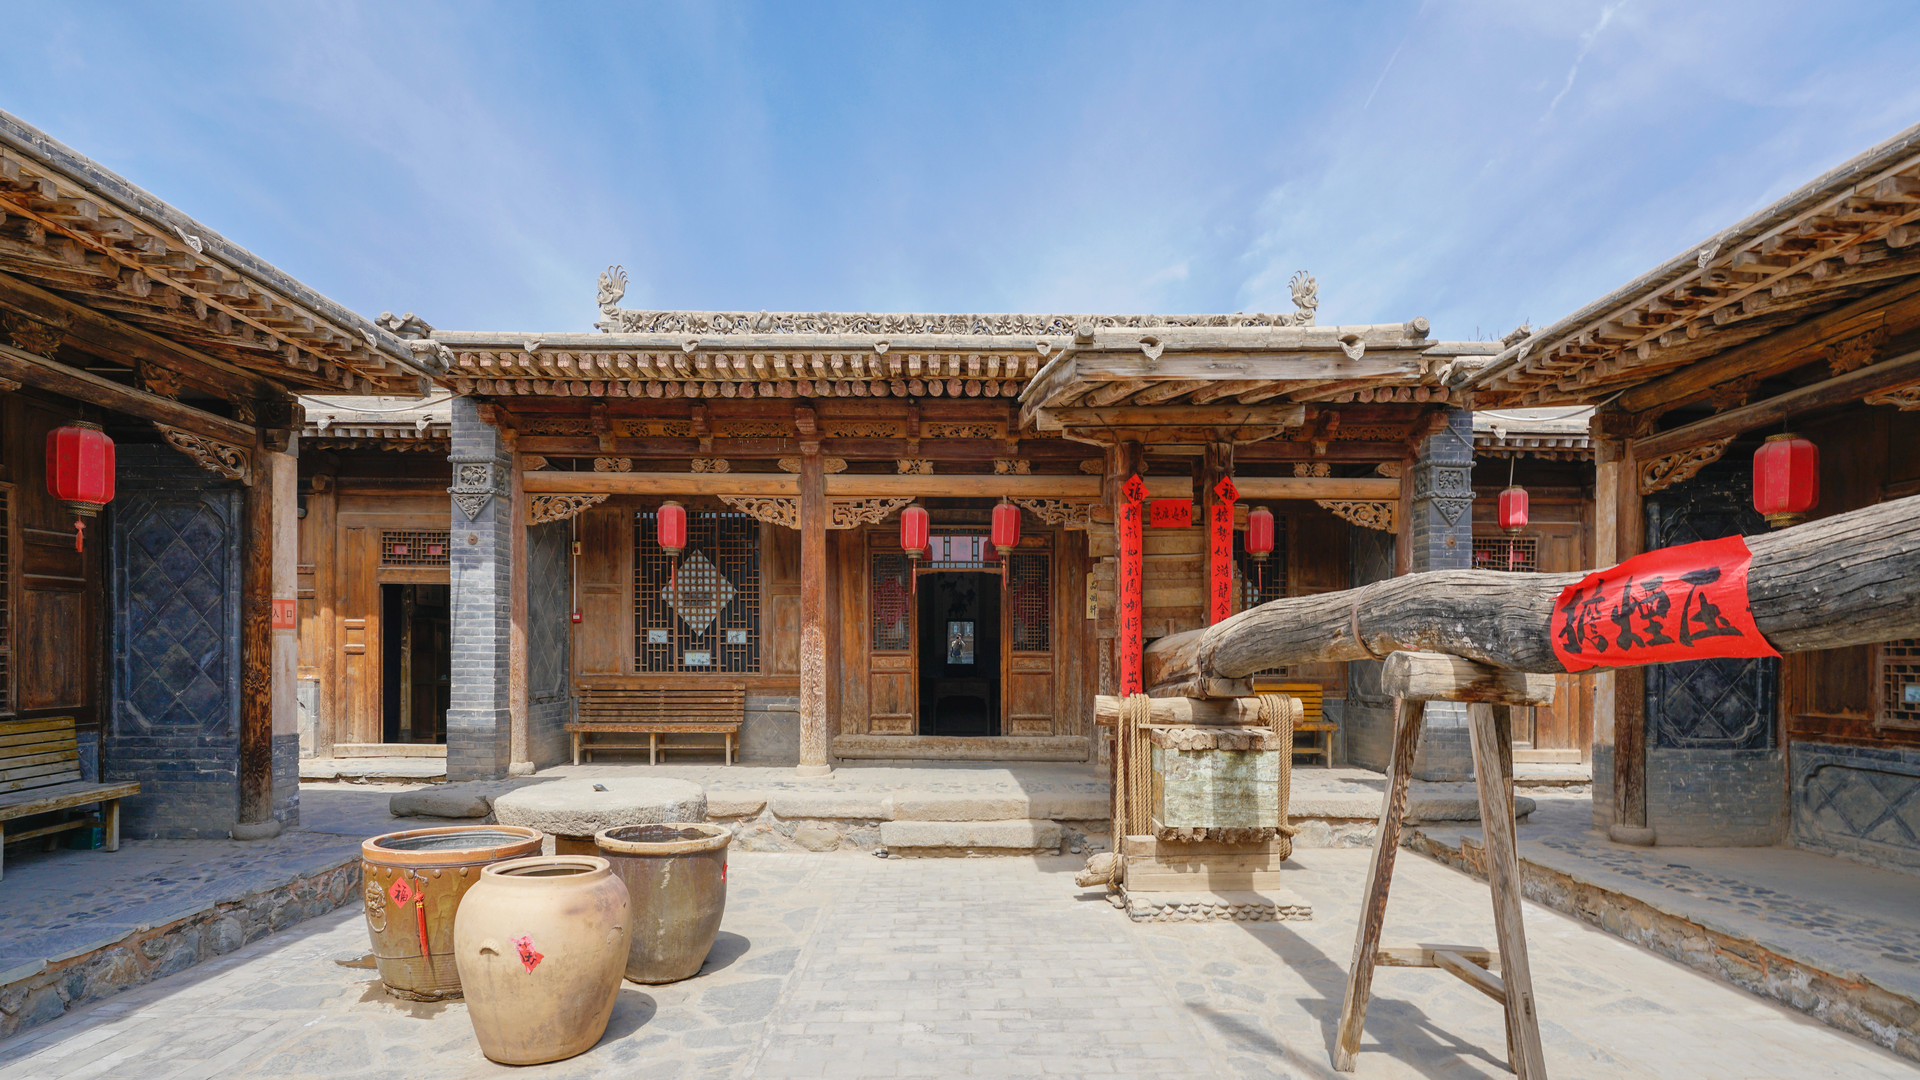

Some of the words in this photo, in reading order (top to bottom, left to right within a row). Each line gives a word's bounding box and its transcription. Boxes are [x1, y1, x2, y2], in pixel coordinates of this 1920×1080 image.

[1128, 483, 1143, 501] 福
[1222, 483, 1236, 501] 福
[272, 608, 293, 618] 入口
[394, 883, 409, 902] 福
